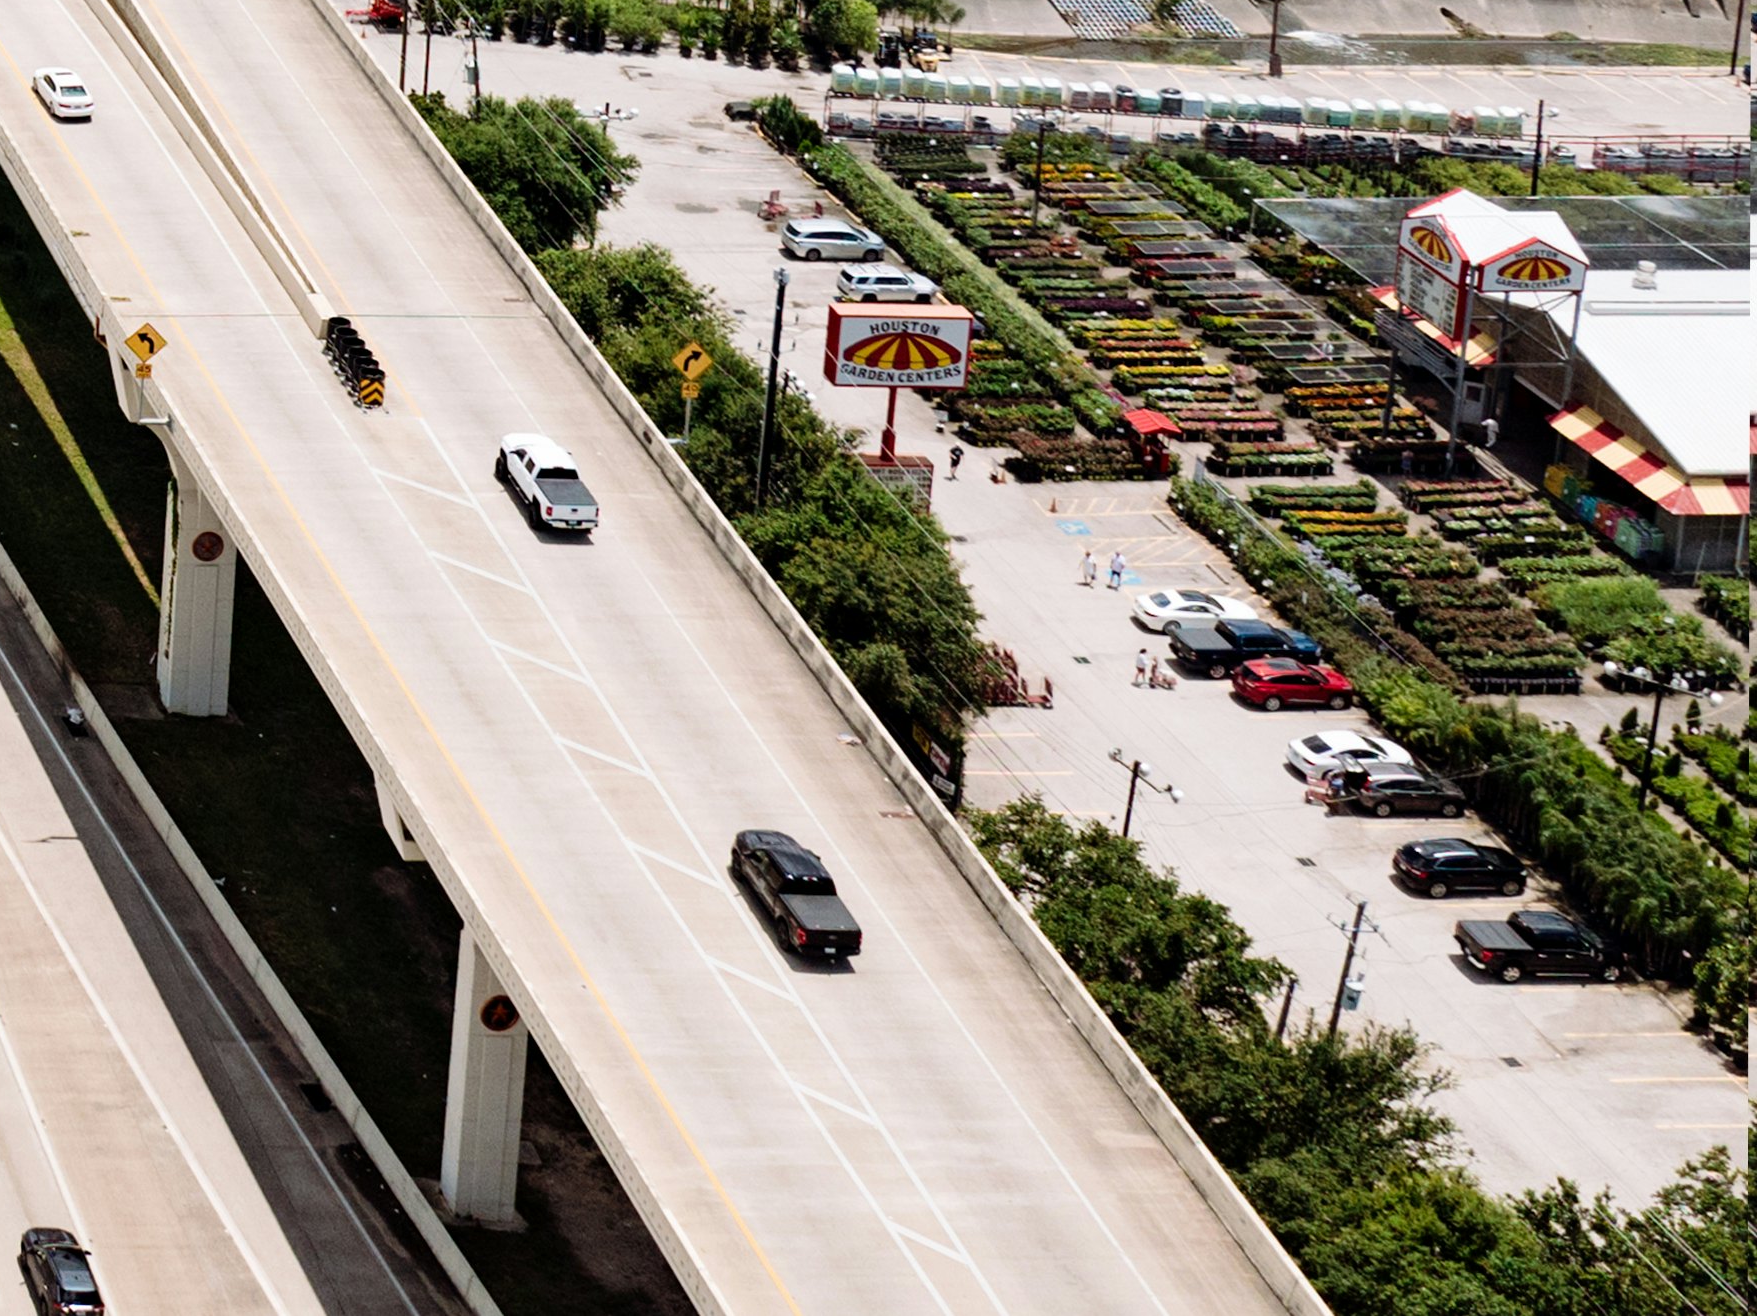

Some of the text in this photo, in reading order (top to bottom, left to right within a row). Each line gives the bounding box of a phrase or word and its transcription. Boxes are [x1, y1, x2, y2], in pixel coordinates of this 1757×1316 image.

[1514, 249, 1559, 258] HOUSTON
[1495, 277, 1571, 289] GARDEN CENTERS
[869, 320, 941, 336] HOUSTON
[839, 363, 962, 383] GARDEN CENTERS
